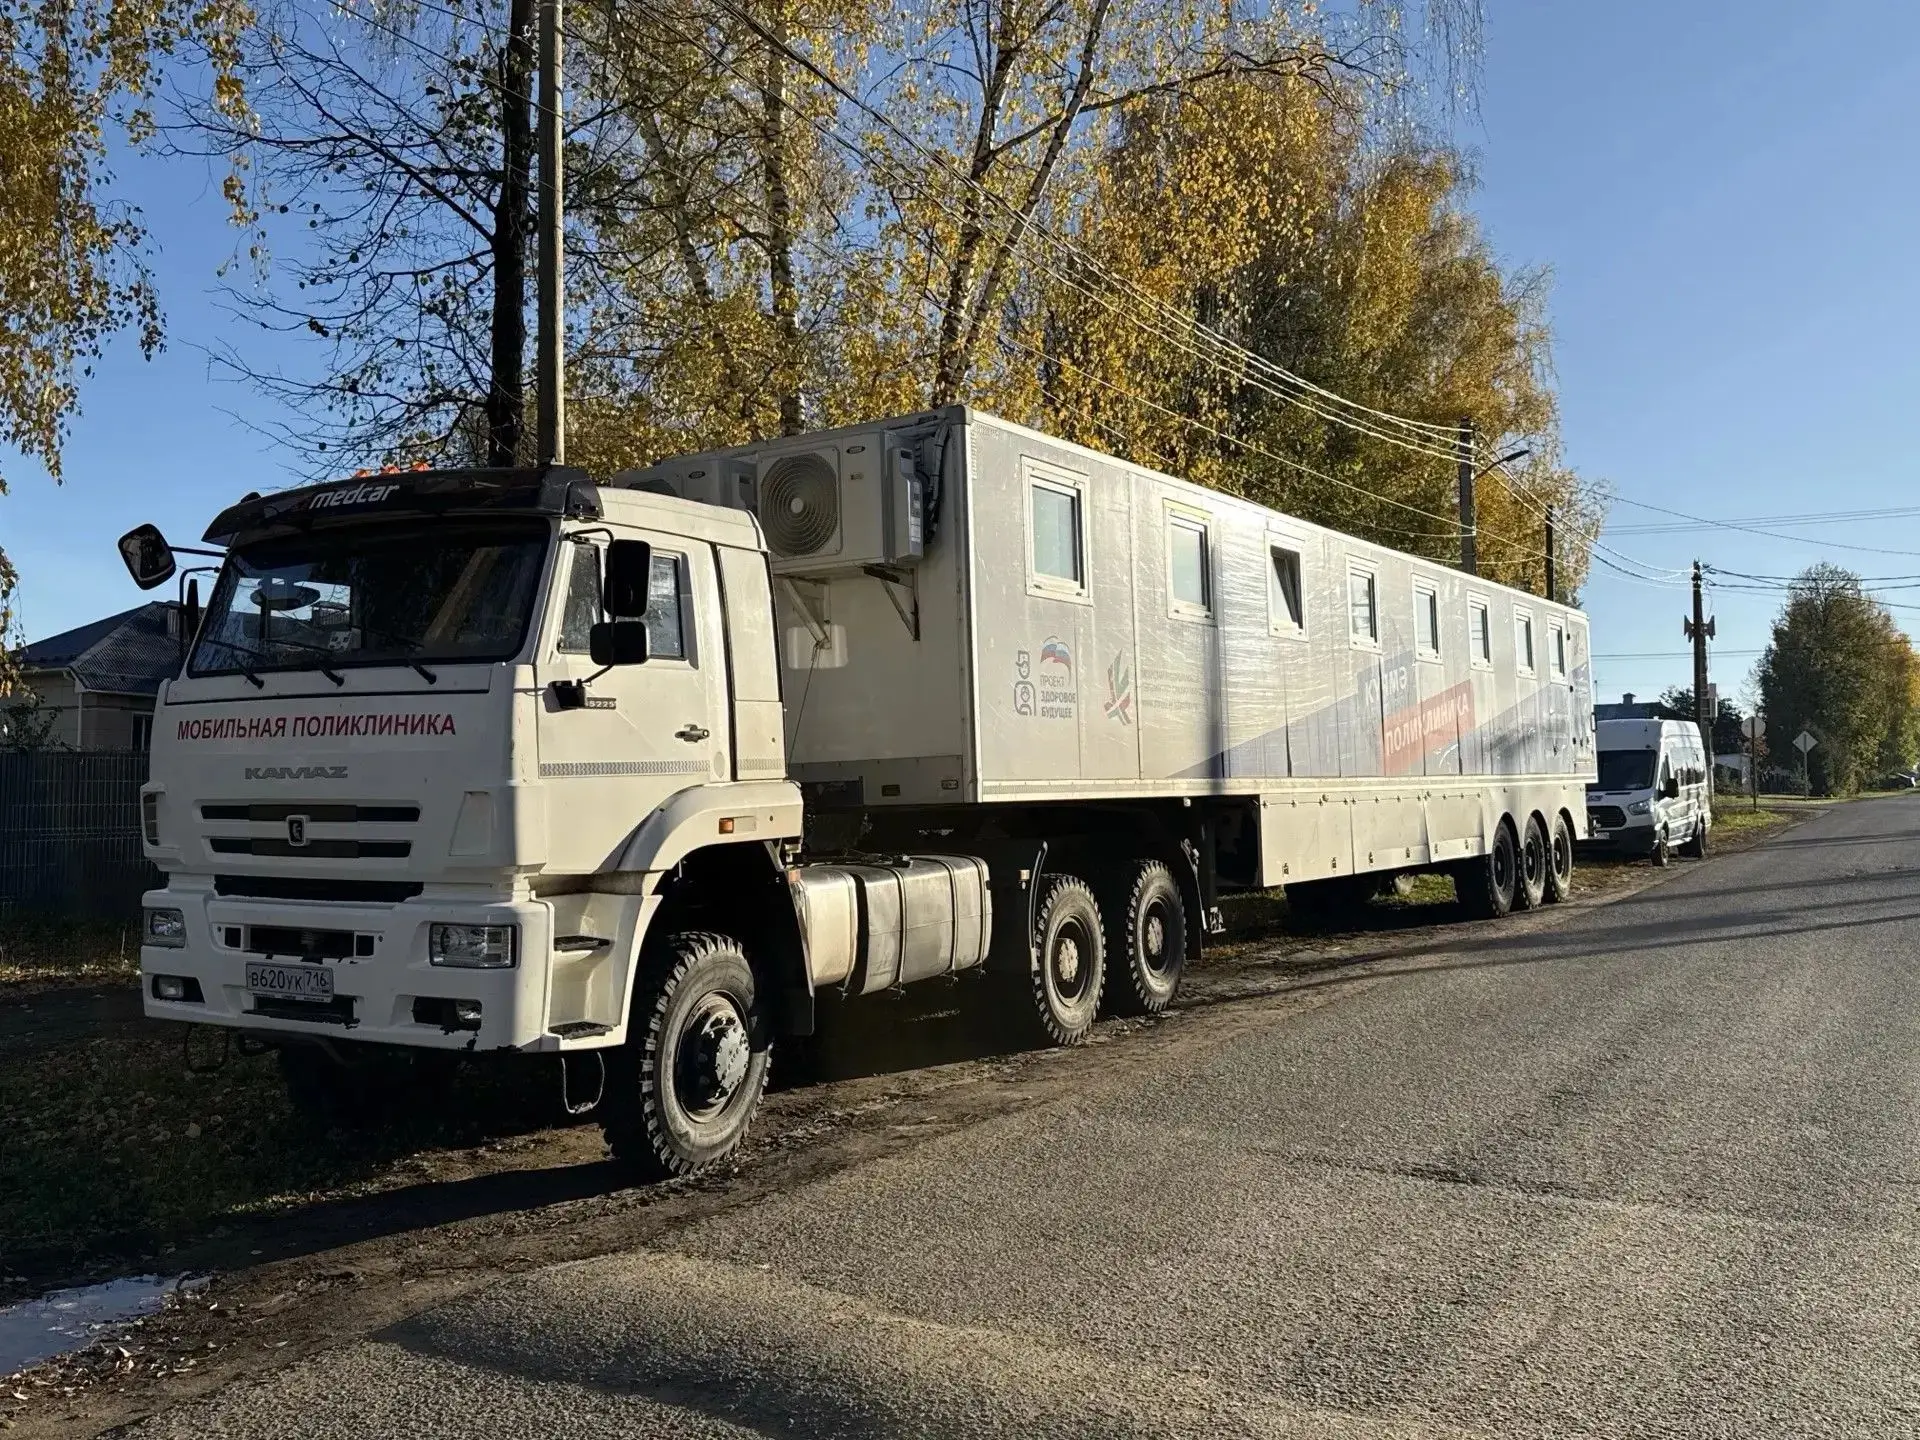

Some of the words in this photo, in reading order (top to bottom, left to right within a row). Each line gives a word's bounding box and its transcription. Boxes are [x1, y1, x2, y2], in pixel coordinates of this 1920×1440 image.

[309, 483, 400, 509] medcar
[1040, 674, 1064, 688] ПРОЕКТ
[1041, 690, 1076, 704] ЗДОРОВОЕ
[1041, 705, 1072, 719] БУДУЩЕЕ
[177, 717, 287, 741] МОБИЛЬНАЯ
[292, 714, 457, 737] ПОЛИКЛИНИКА
